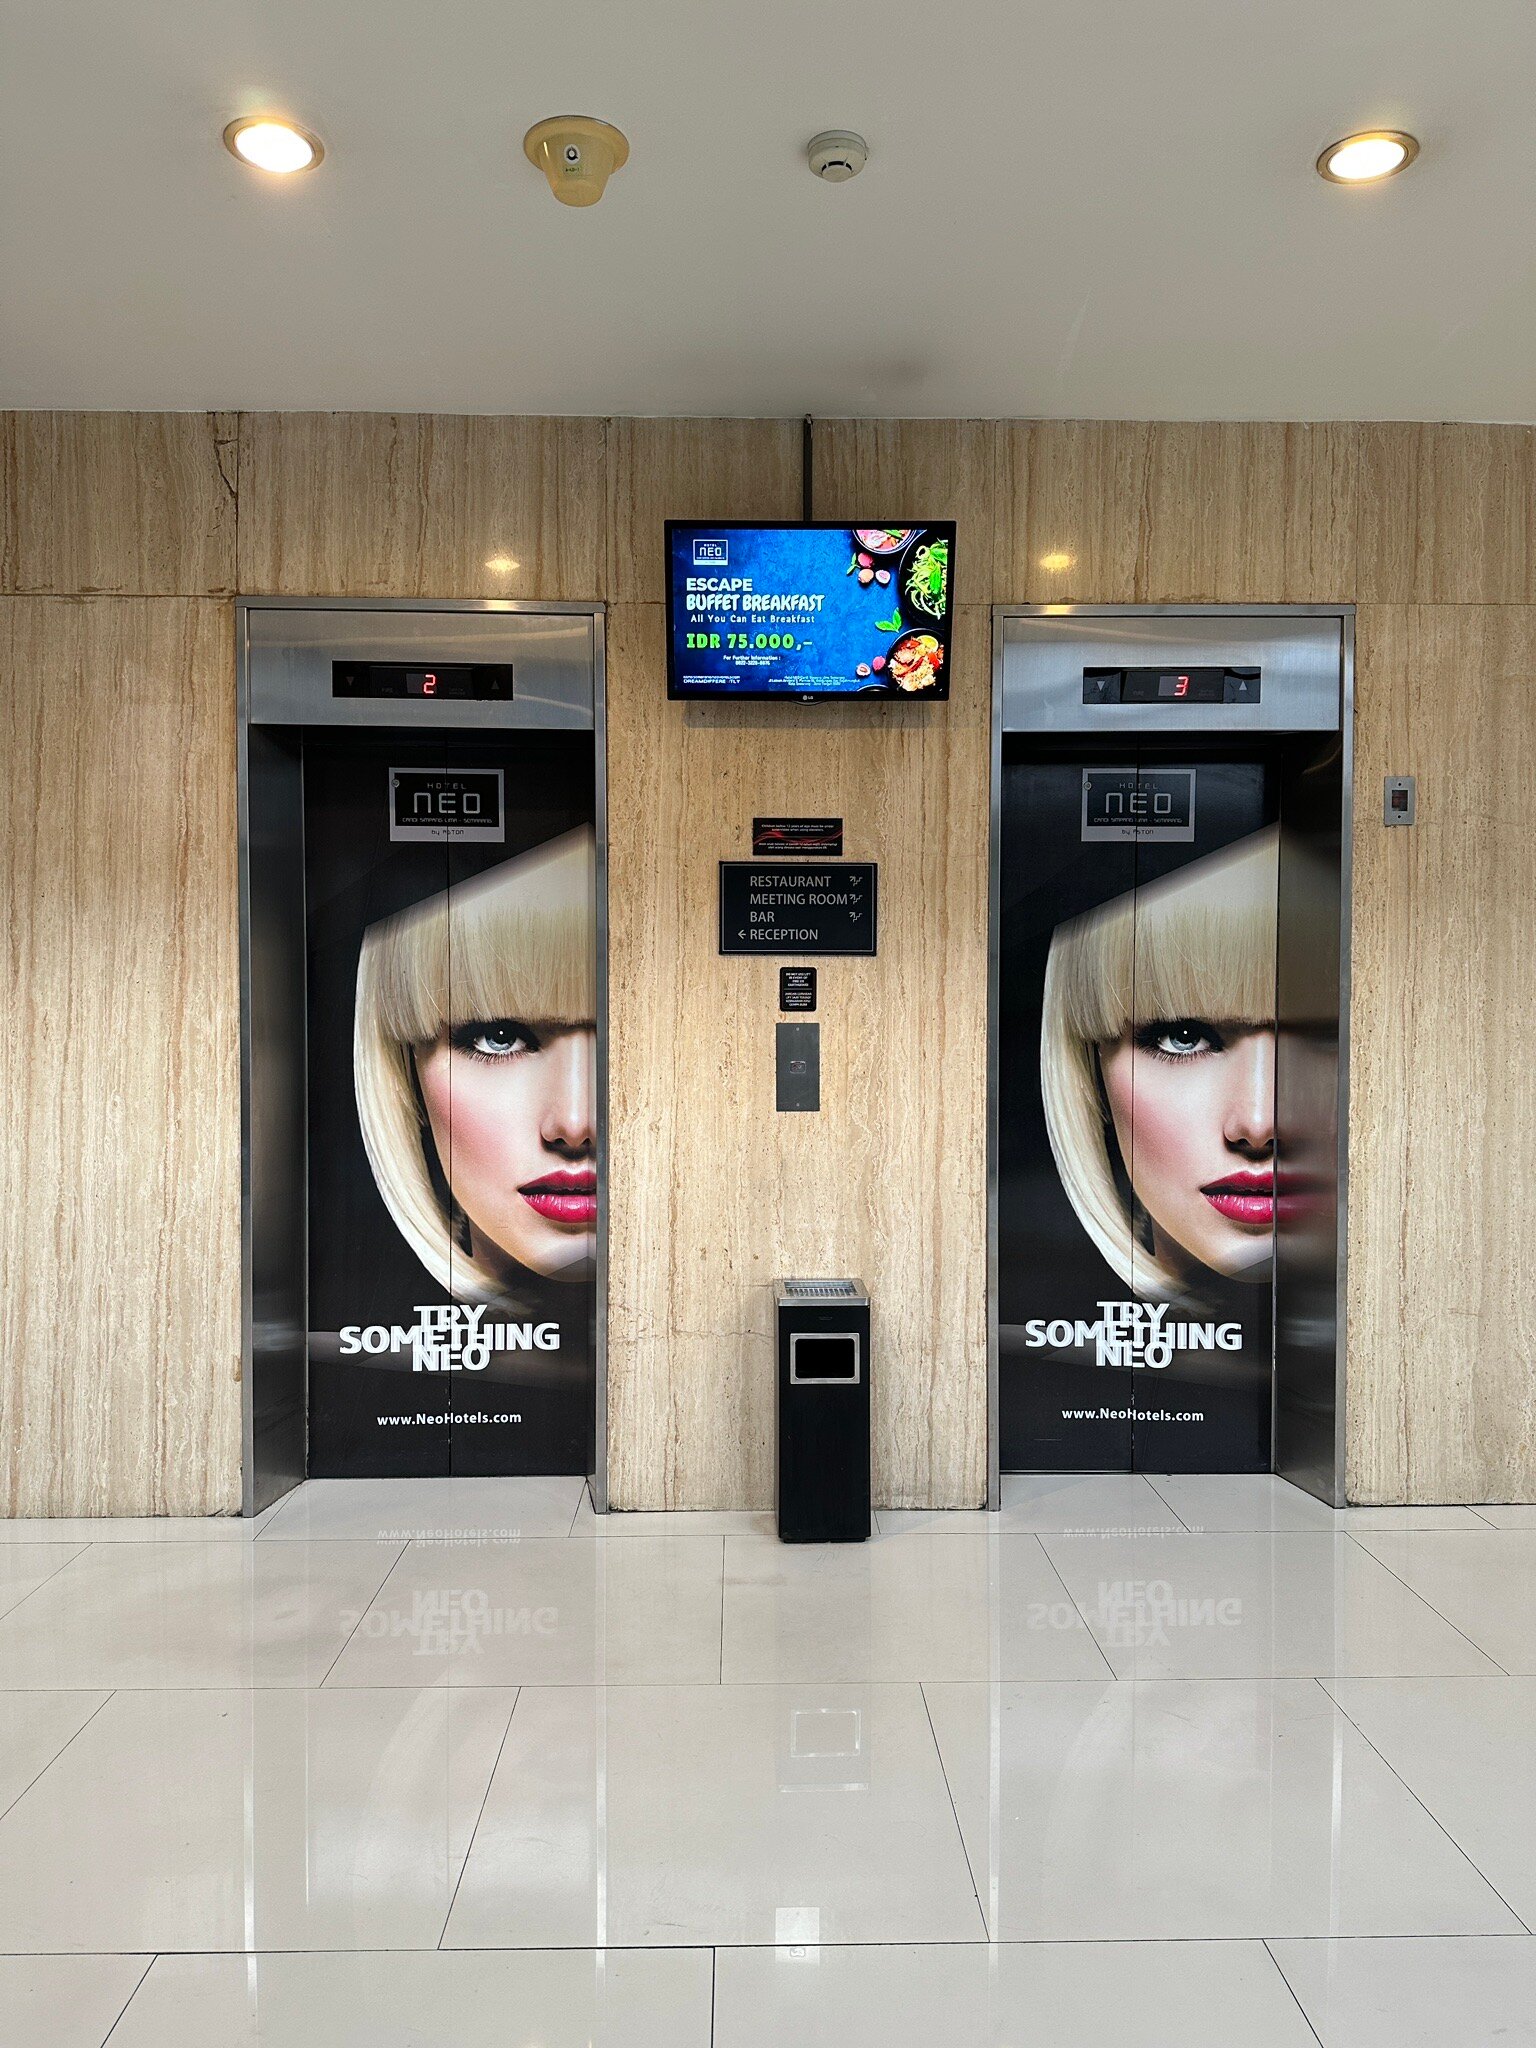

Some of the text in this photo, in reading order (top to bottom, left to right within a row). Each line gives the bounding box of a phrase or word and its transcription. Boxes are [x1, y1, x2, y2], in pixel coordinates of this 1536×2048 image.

[686, 578, 753, 591] ESCAPE
[686, 594, 825, 611] BUFFET BREAKFAST
[691, 615, 815, 623] All You Can Eat Breakfast
[687, 633, 720, 649] IDR
[423, 674, 436, 694] 2
[1174, 676, 1190, 696] 3
[750, 876, 832, 887] RESTAURANT
[750, 894, 848, 905] MEETING ROOM
[750, 911, 775, 923] BAR
[750, 929, 819, 940] RECEPTION
[413, 1304, 488, 1331] TRY
[1096, 1301, 1170, 1330] TRY
[339, 1322, 560, 1354] SOMETHING
[1025, 1320, 1243, 1350] SOMETHING
[412, 1343, 491, 1372] NEO
[1096, 1340, 1172, 1369] NEO
[377, 1411, 522, 1425] www.NeoHotels.com
[1061, 1407, 1204, 1421] www.NeoHotels.com
